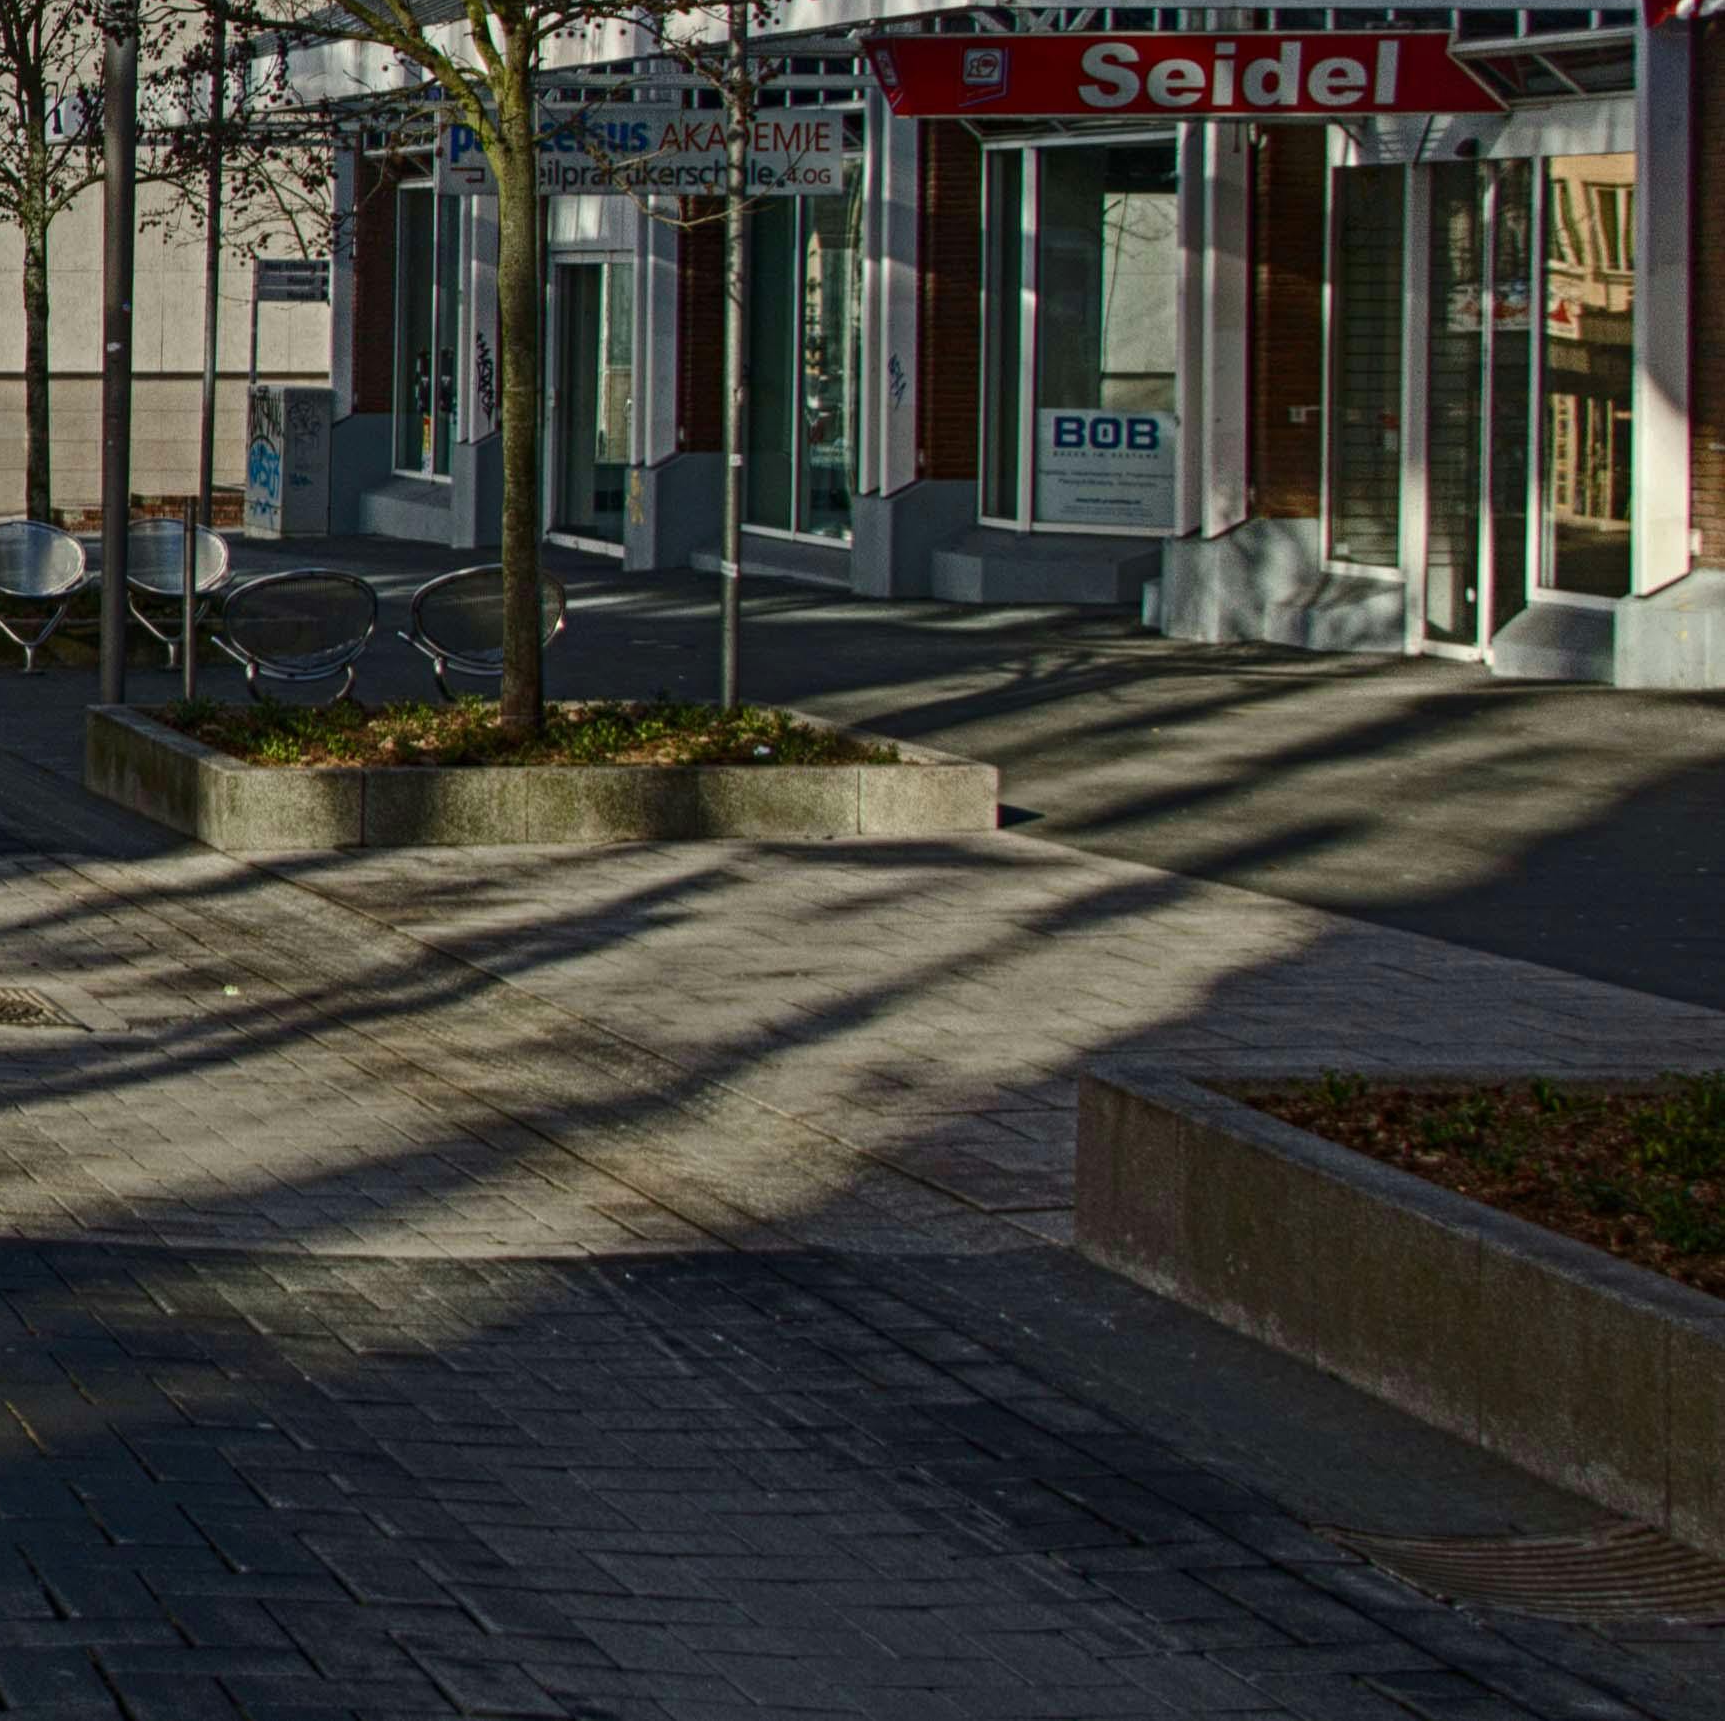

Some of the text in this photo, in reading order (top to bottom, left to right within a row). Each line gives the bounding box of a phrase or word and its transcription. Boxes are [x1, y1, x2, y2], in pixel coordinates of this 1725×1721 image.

[1077, 39, 1400, 108] Seidel
[450, 110, 648, 163] pcelsus
[1054, 416, 1159, 450] BOB
